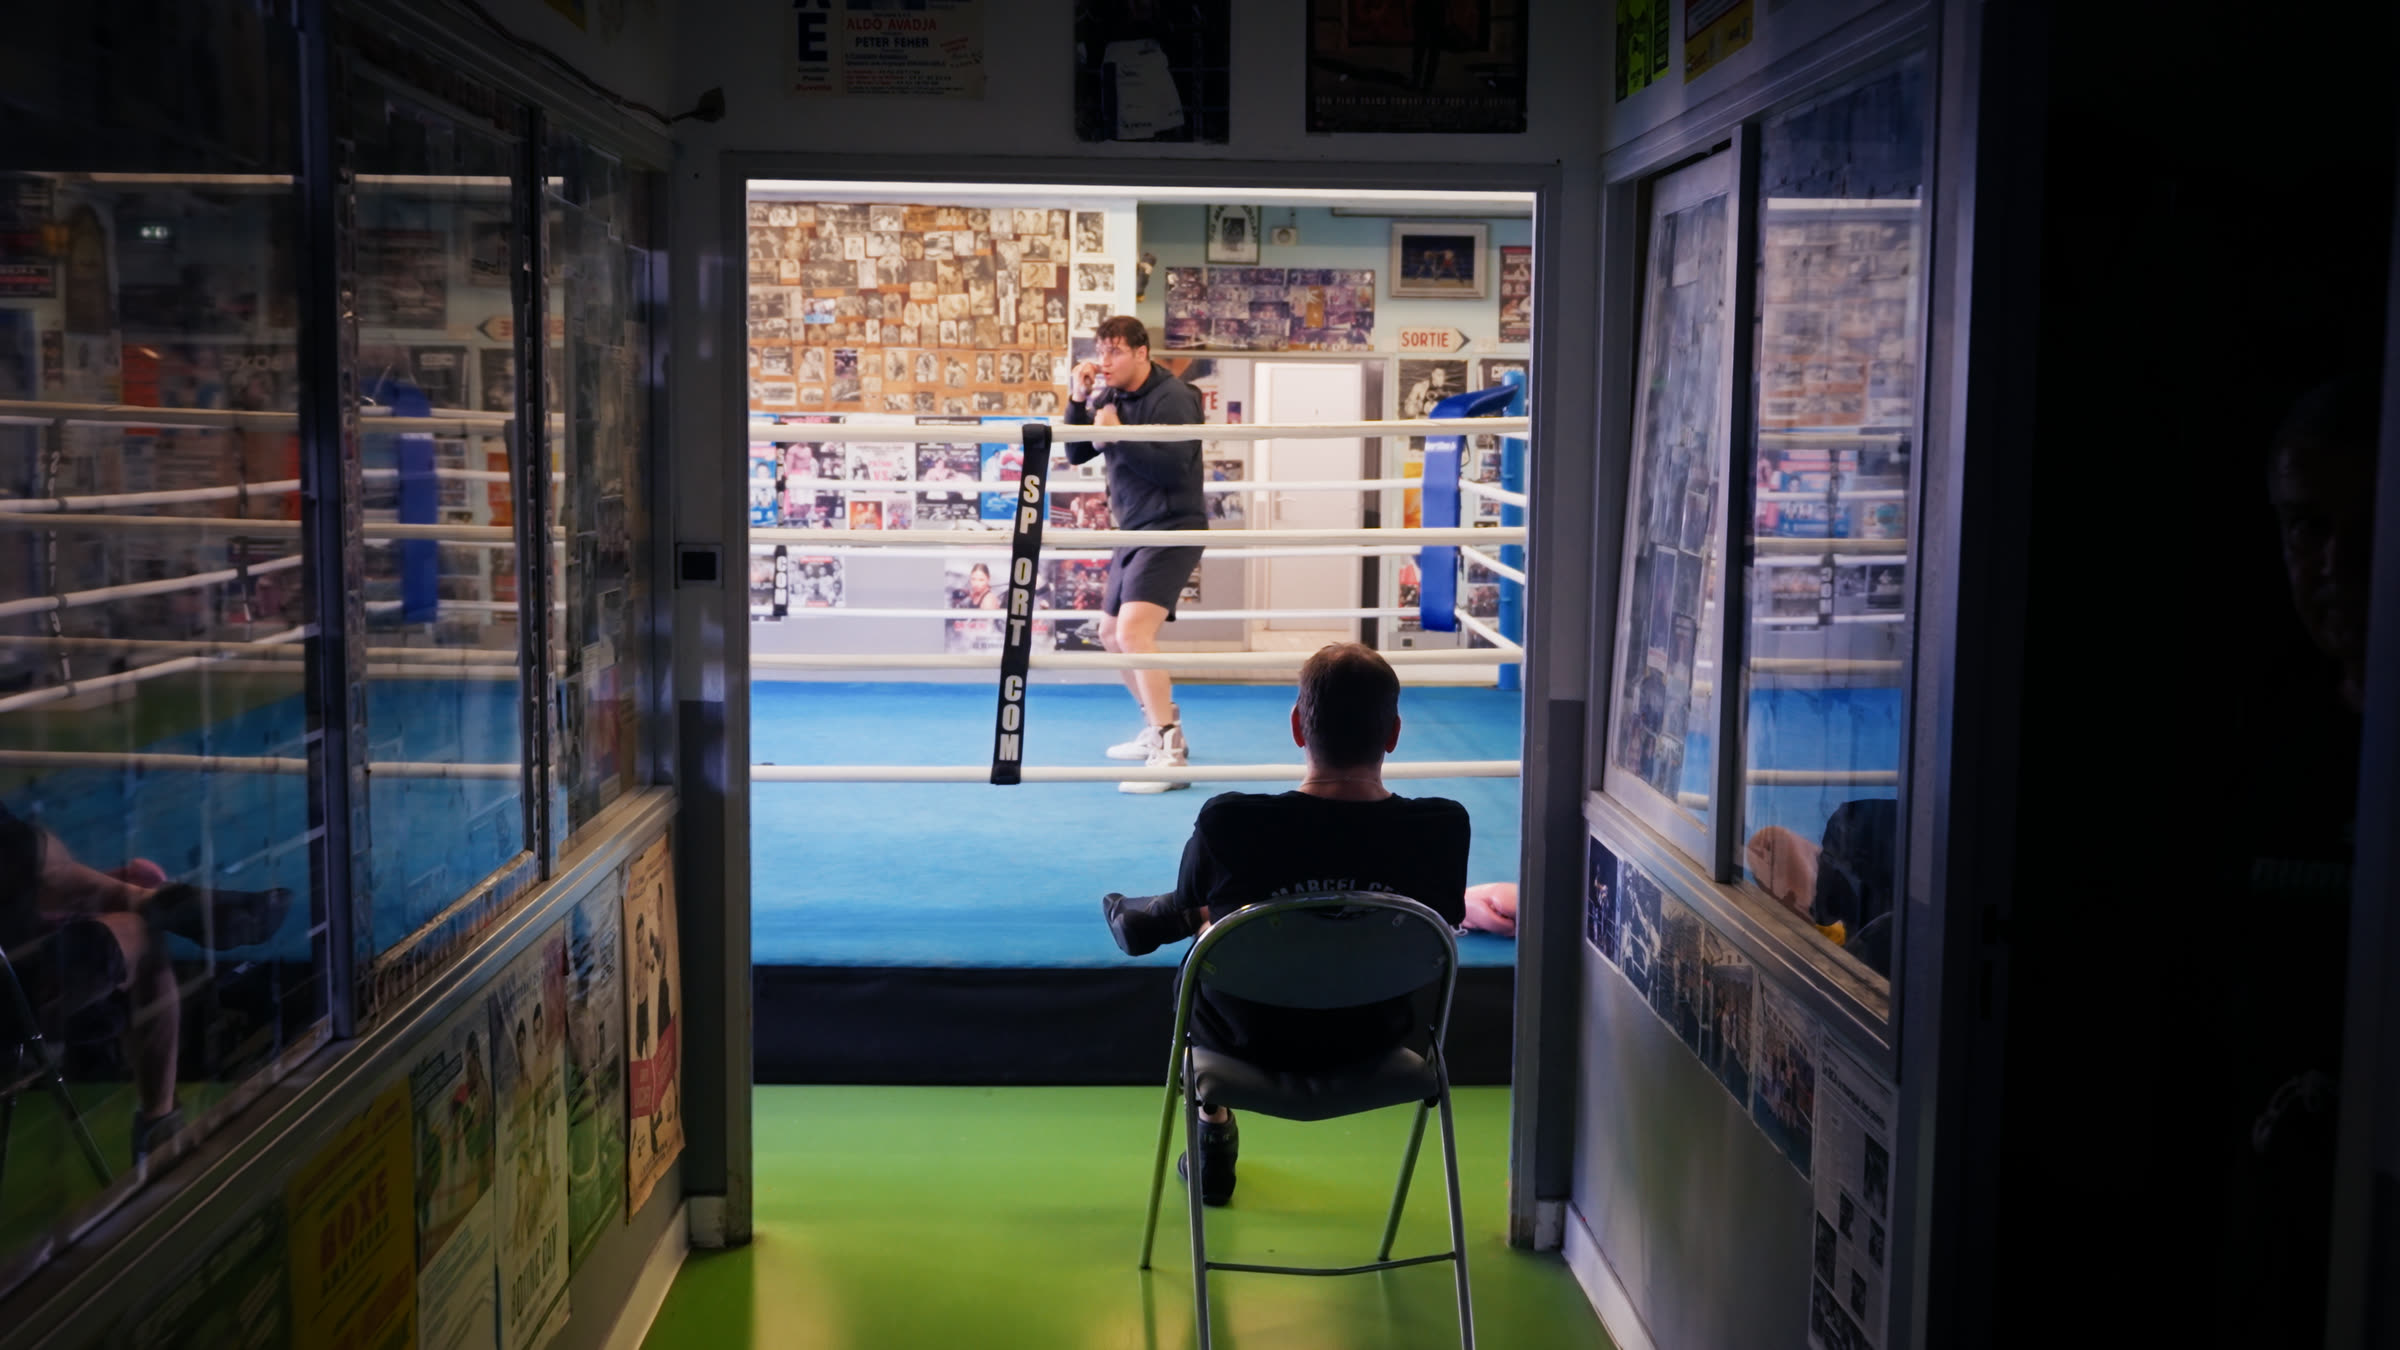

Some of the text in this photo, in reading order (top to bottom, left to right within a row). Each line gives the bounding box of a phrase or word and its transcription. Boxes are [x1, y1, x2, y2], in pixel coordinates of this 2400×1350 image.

[793, 0, 832, 62] E
[846, 18, 937, 31] ALDO AVADJA
[855, 36, 889, 48] PETER
[1401, 331, 1449, 348] SORTIE
[999, 675, 1023, 761] COM
[1271, 879, 1356, 897] MARCEL
[320, 1168, 388, 1272] BOXE
[542, 1221, 559, 1274] DAY
